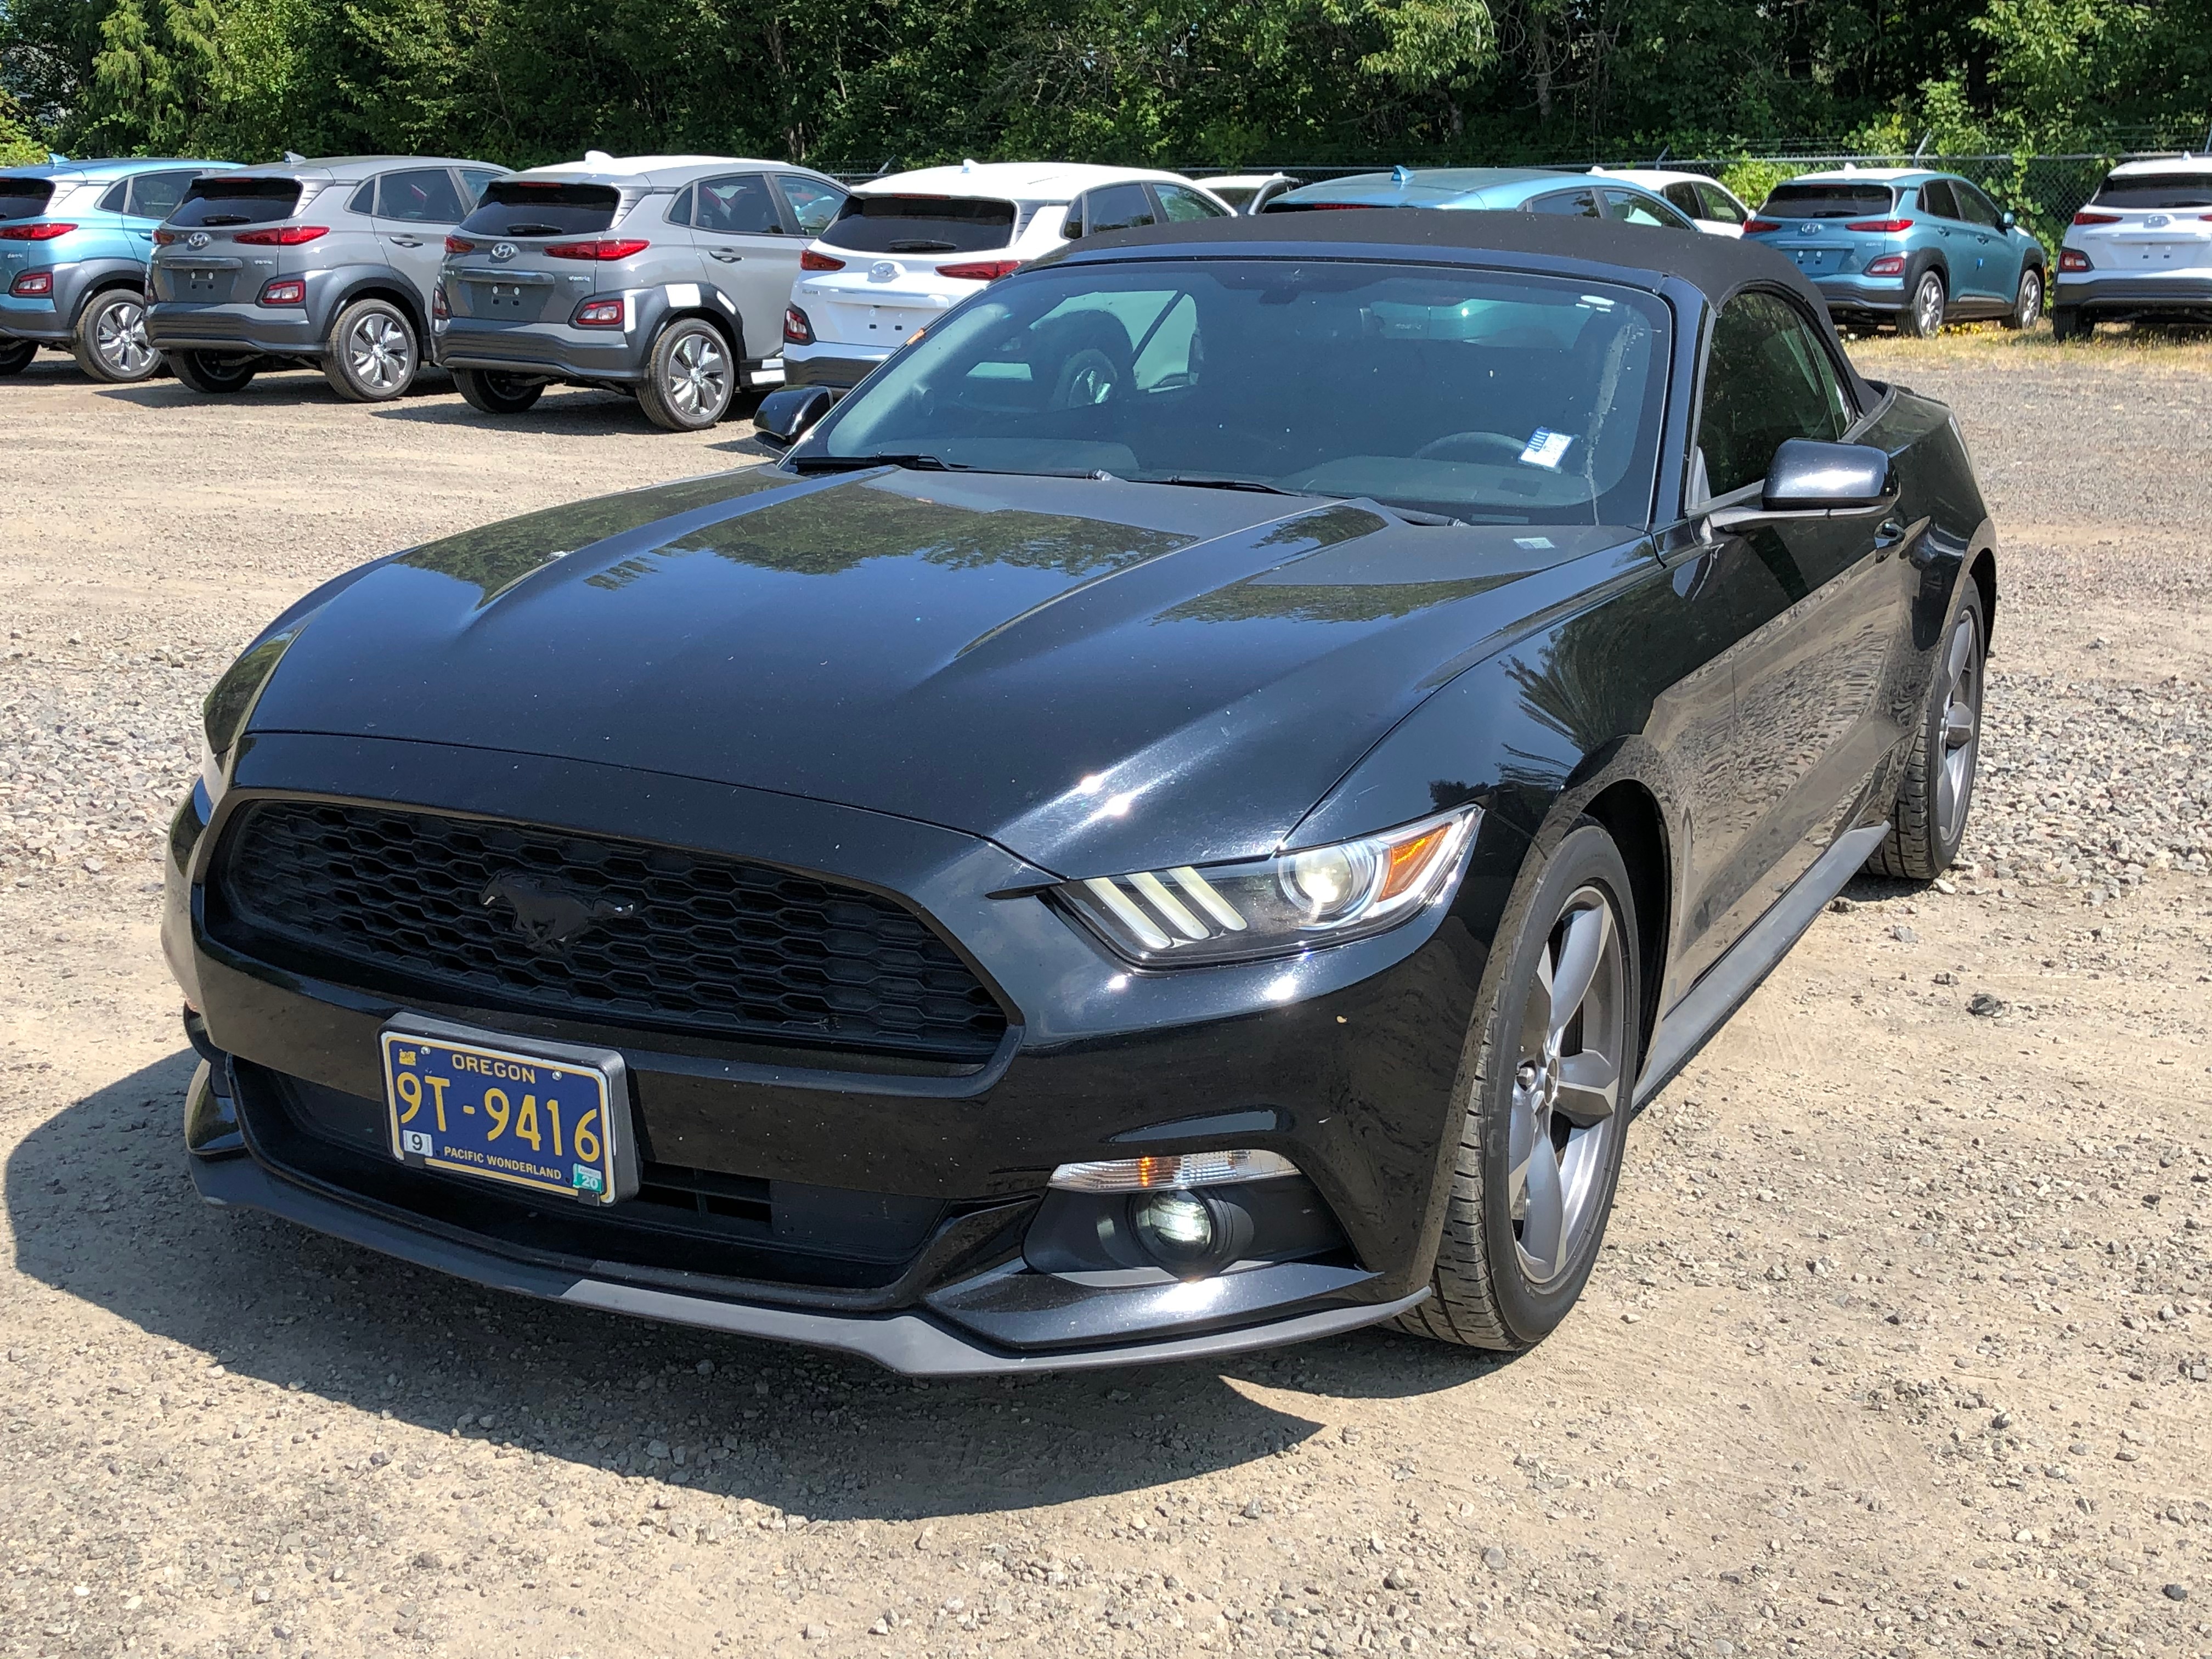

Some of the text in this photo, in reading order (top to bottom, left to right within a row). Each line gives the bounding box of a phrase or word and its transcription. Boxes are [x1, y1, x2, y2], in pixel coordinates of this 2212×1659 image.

[452, 1053, 536, 1084] OREGON
[397, 1071, 600, 1163] 9T-9416
[411, 1133, 423, 1151] 9
[444, 1146, 484, 1163] PACIFIC
[486, 1154, 562, 1180] WONDERLAND
[582, 1175, 599, 1189] 20
